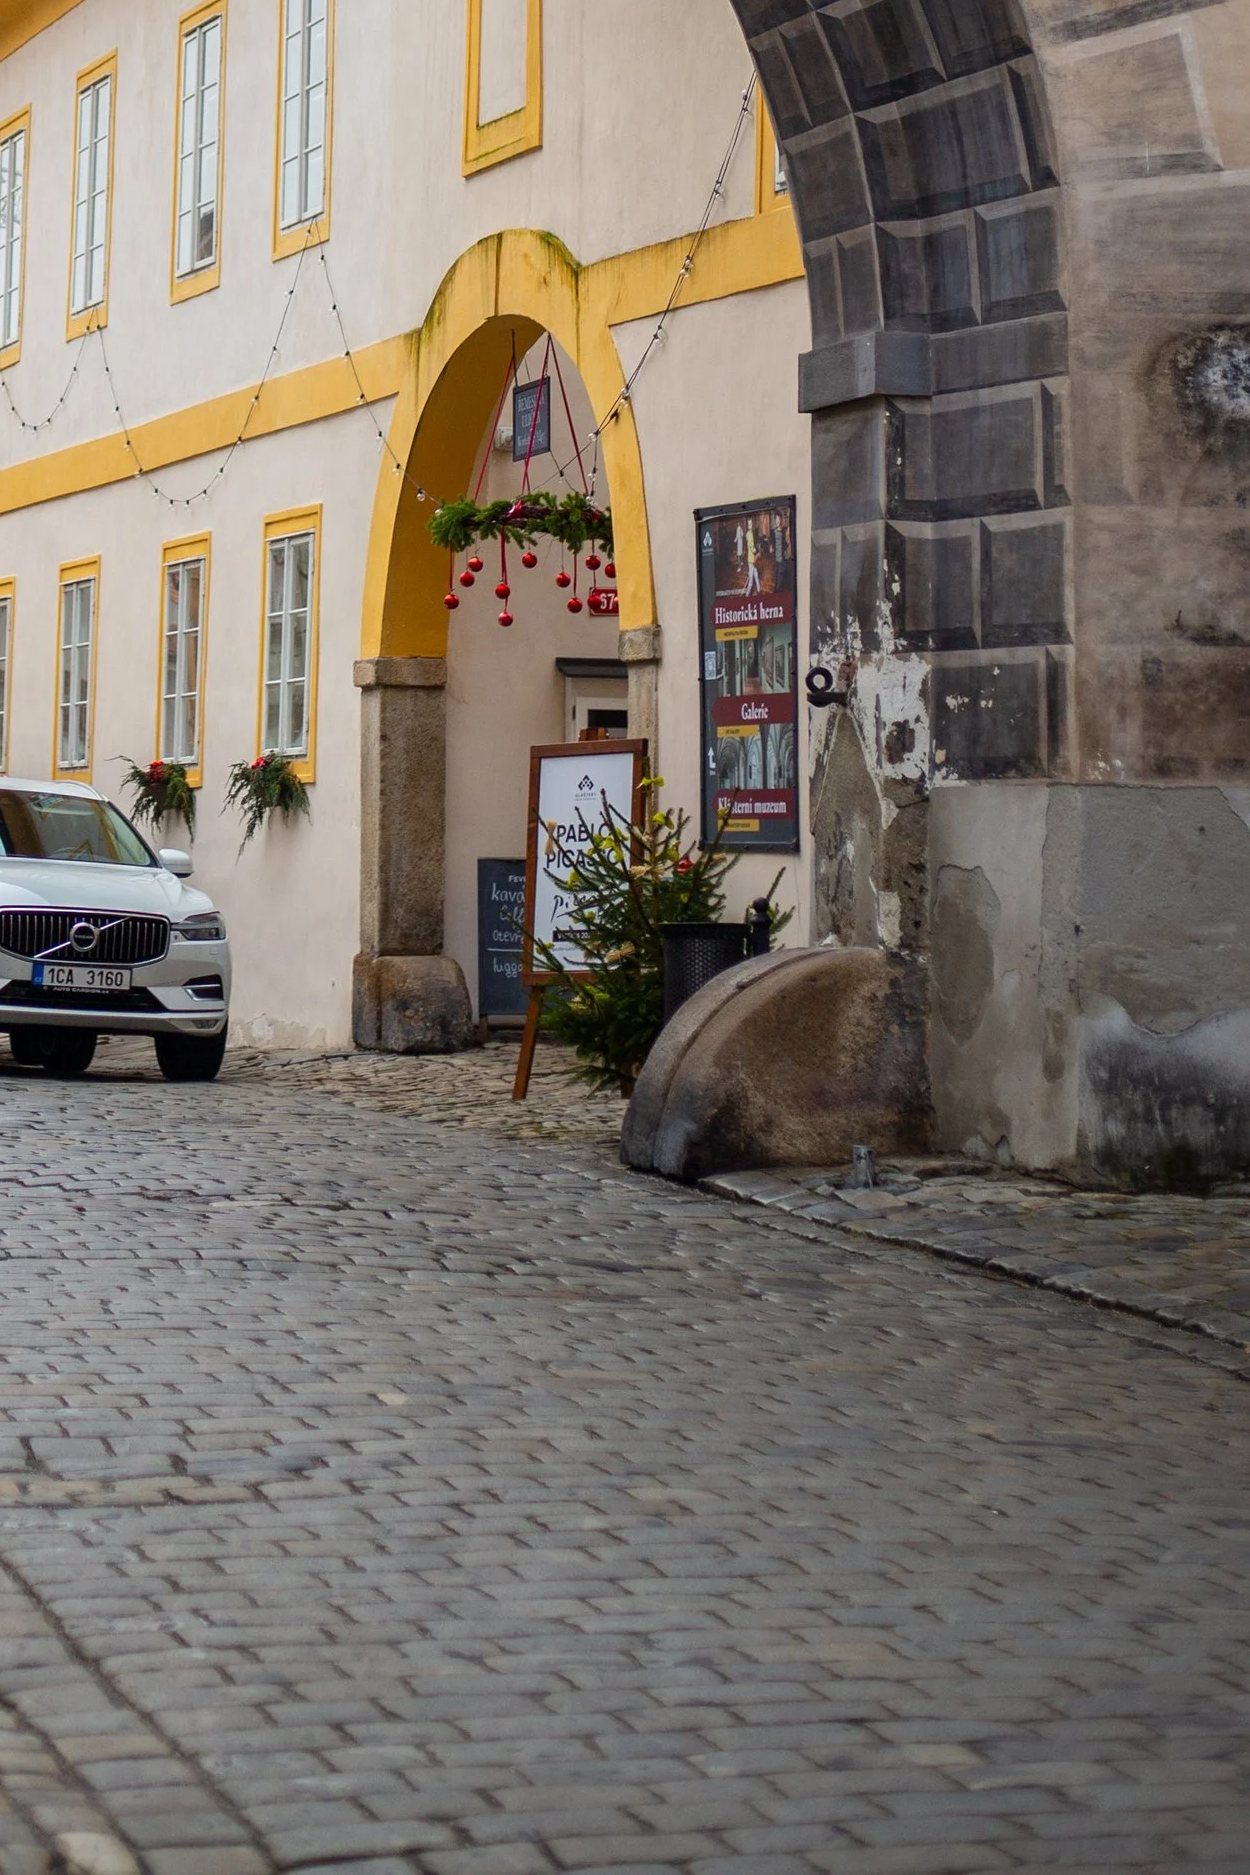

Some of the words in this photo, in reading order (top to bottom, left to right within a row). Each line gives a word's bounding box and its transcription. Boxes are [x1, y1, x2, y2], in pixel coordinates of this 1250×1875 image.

[715, 603, 758, 624] Historická
[759, 602, 784, 620] herna
[741, 702, 769, 720] Galerie
[754, 802, 787, 814] muzeum
[546, 848, 622, 869] PICAO
[48, 968, 74, 985] 1CA
[86, 970, 123, 986] 3160
